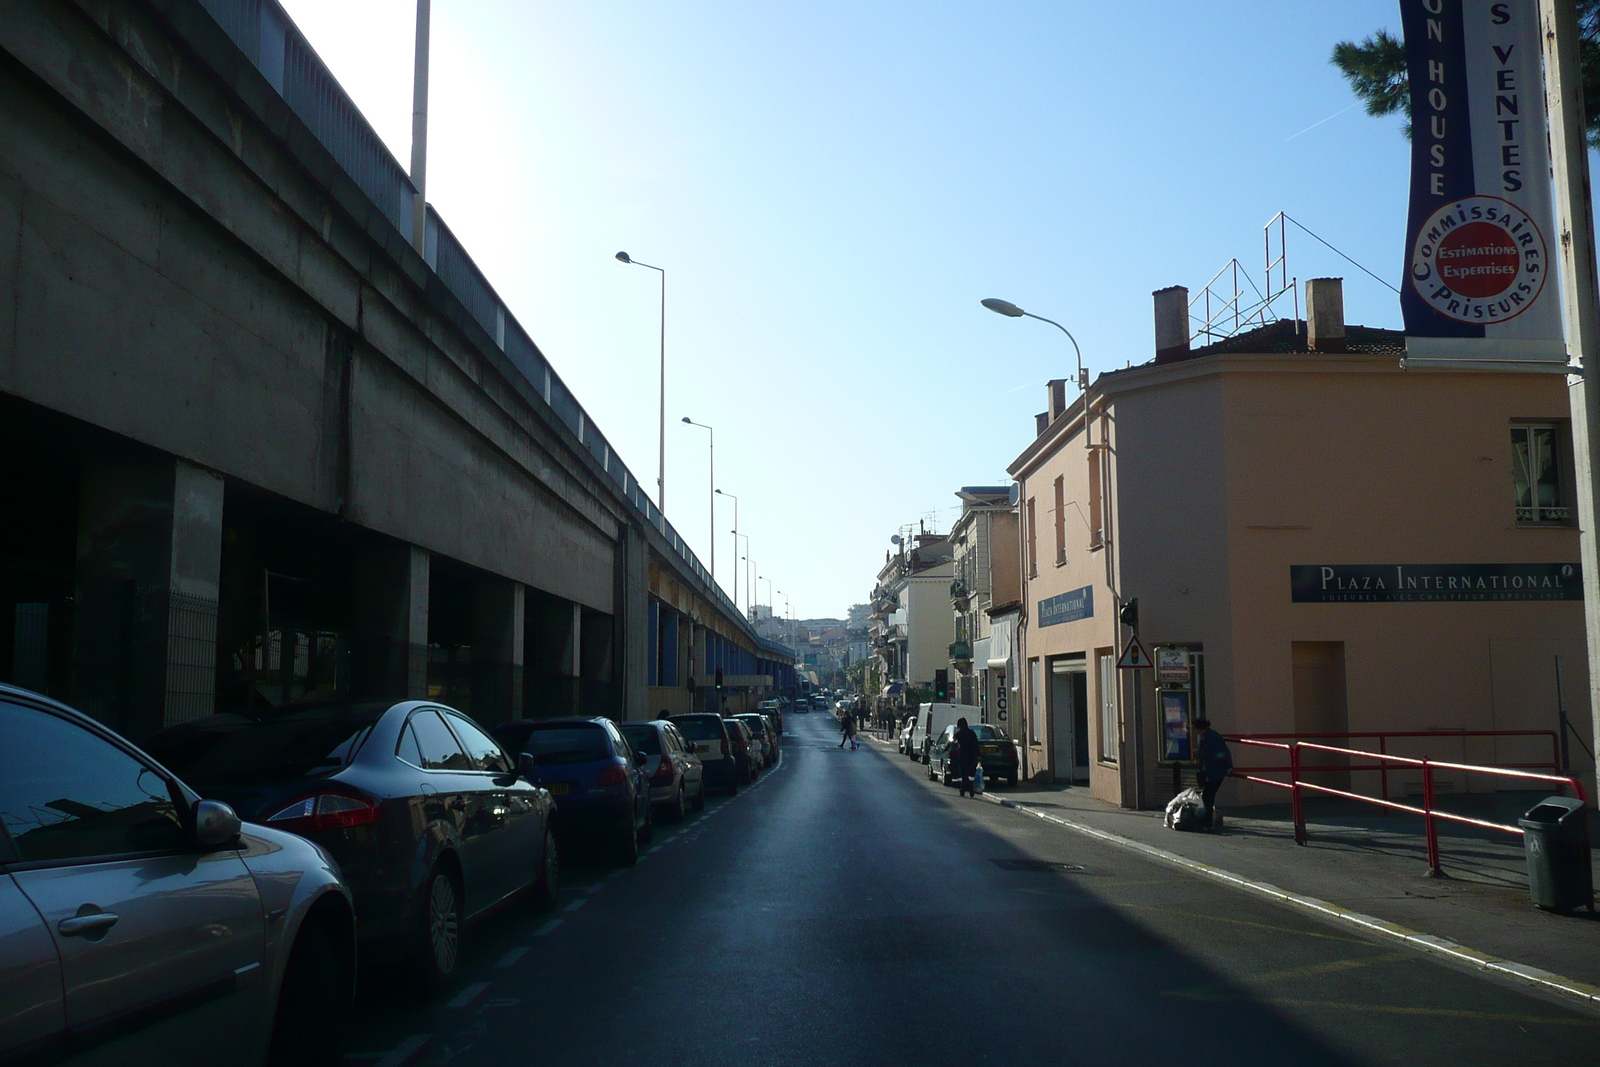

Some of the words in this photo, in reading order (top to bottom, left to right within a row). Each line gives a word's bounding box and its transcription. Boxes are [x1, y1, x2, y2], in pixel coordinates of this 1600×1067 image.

[1428, 59, 1448, 197] HOUSE
[1491, 44, 1523, 194] VENTES
[1412, 203, 1540, 282] COMMISSAIRES
[1430, 282, 1532, 319] PRISEURS
[1320, 566, 1386, 590] PLAZA
[1396, 565, 1564, 590] INTERNATIONAL
[1321, 593, 1378, 601] VOITURES
[1385, 593, 1413, 601] AVEC
[1419, 592, 1485, 601] CHAUFFEUR
[1492, 592, 1533, 600] DEPUIS
[1052, 597, 1085, 616] INTERNATIONAL
[997, 674, 1007, 722] TROC
